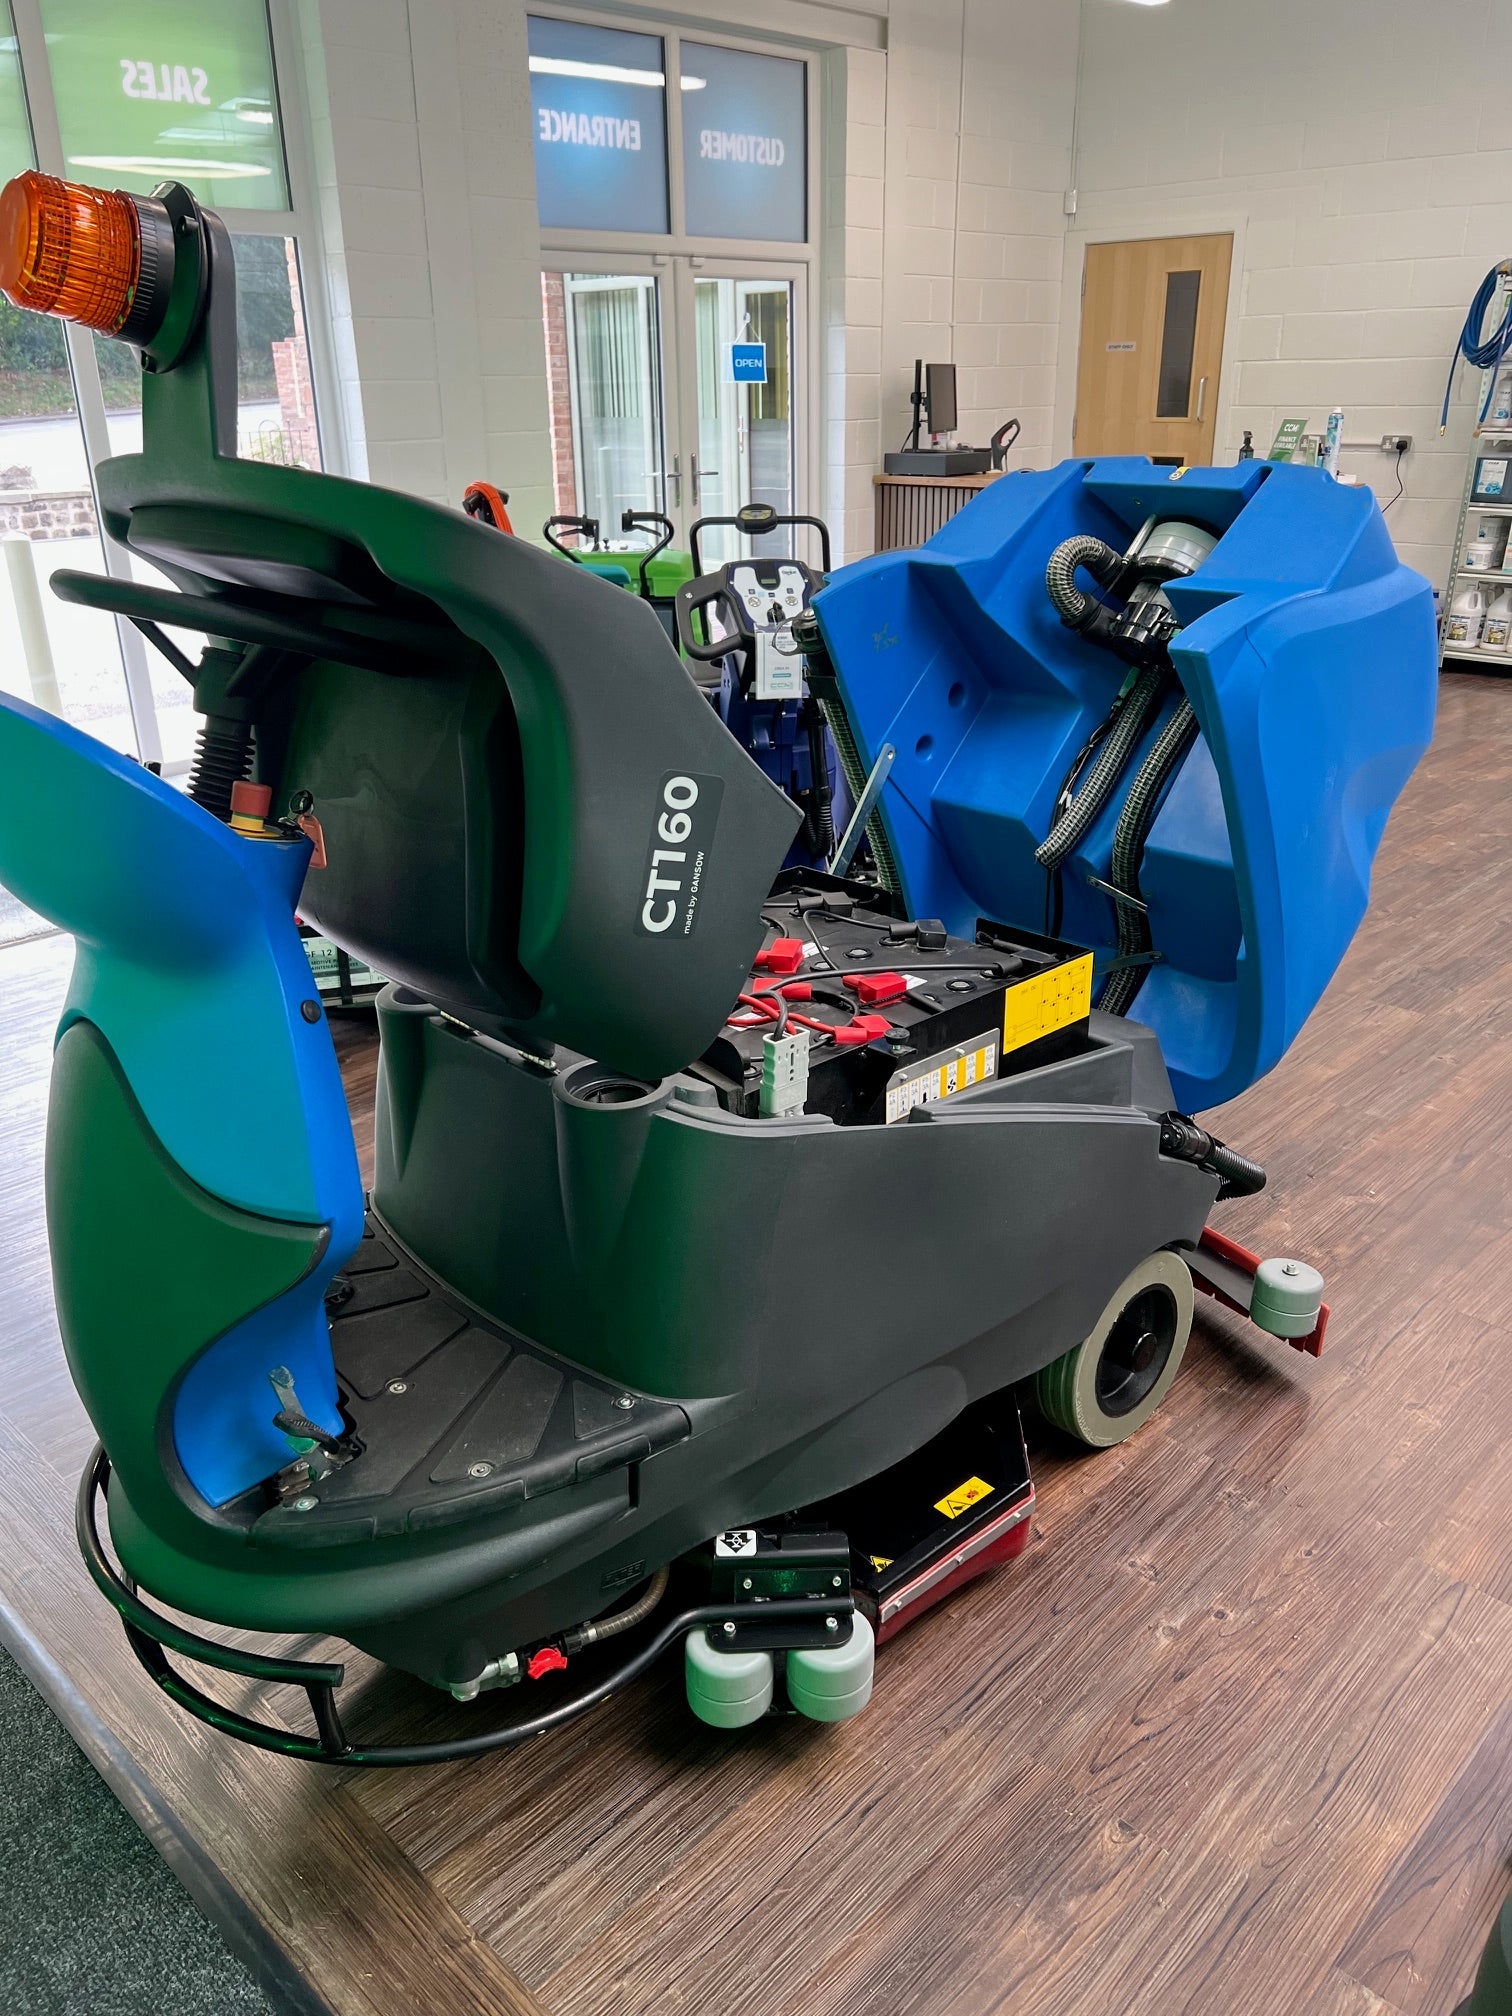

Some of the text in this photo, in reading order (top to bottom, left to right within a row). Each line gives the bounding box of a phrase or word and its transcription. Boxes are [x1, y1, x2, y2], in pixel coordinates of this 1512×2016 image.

[735, 358, 762, 368] OPEN
[642, 776, 698, 932] CT160
[684, 851, 705, 934] made by GANSOW
